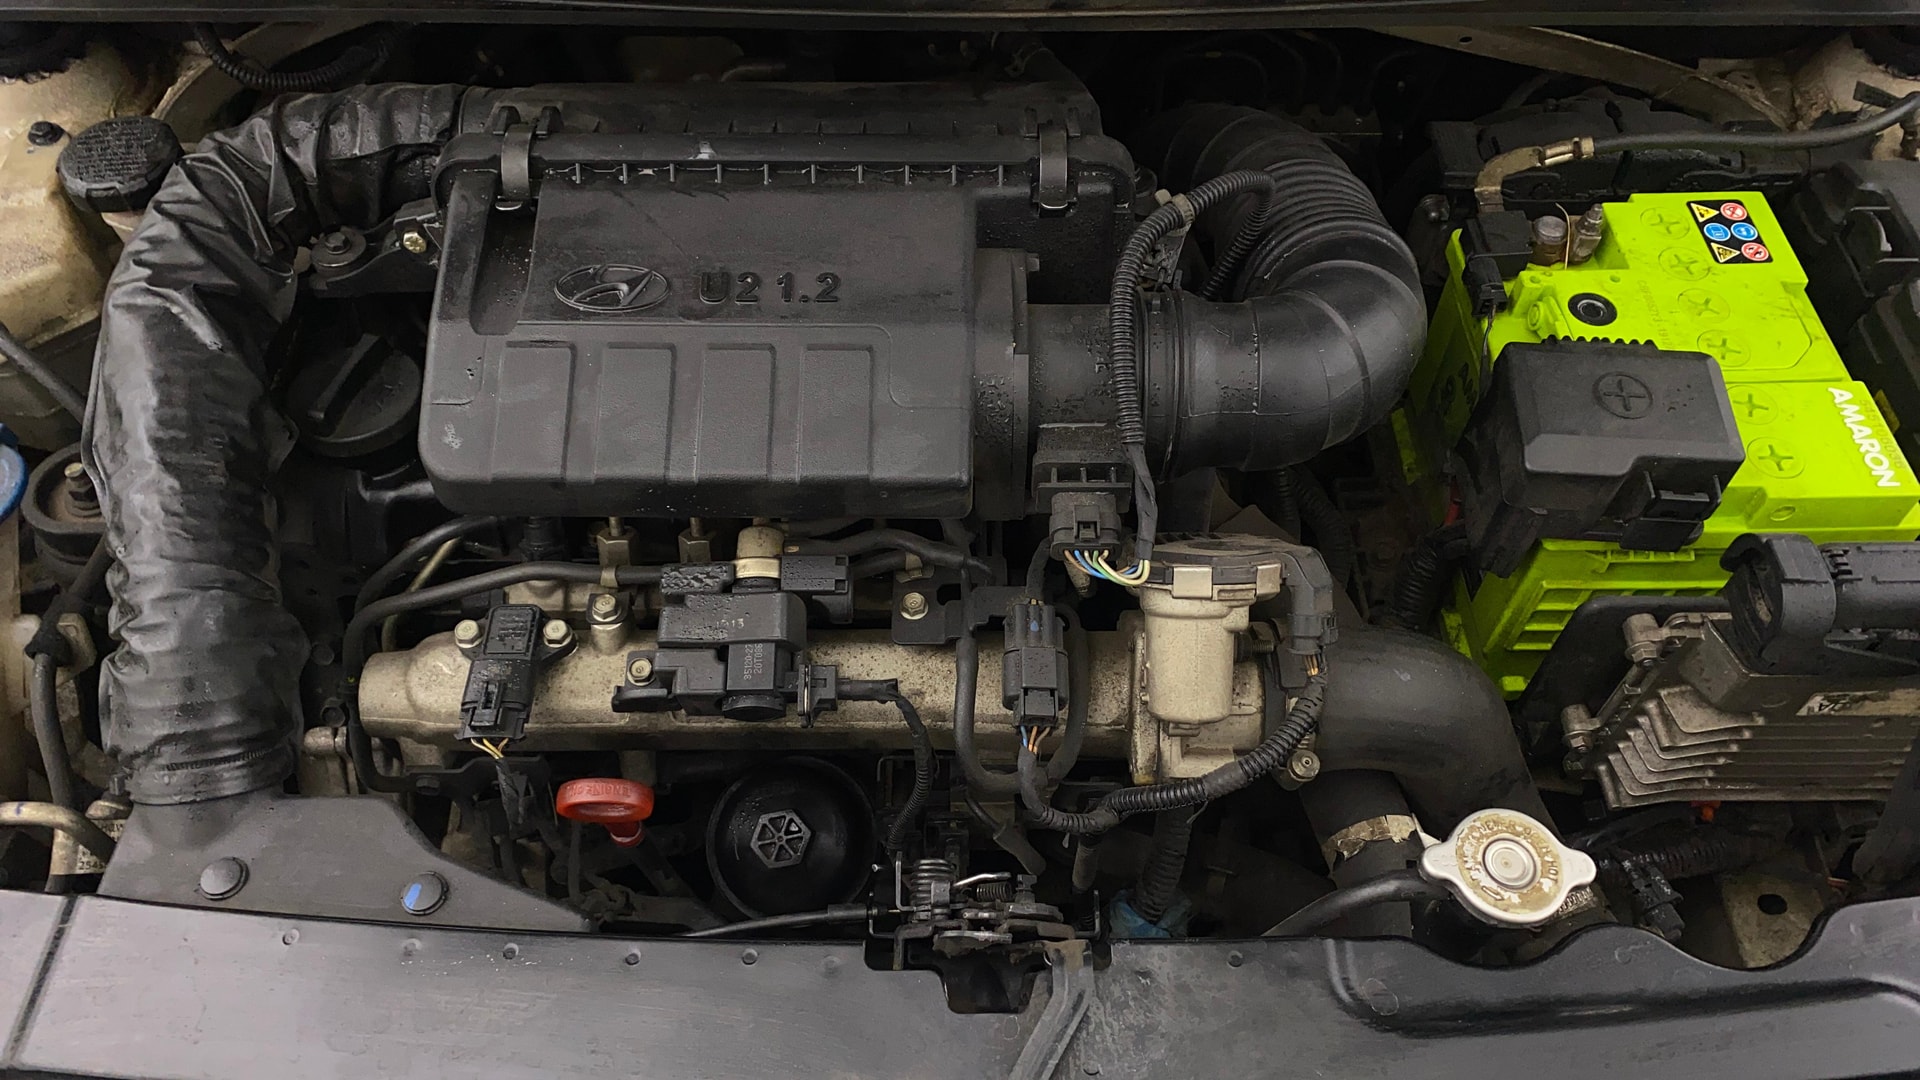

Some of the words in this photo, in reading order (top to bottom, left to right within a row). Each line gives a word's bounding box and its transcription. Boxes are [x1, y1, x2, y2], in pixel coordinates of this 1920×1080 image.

[699, 271, 761, 304] U2
[777, 271, 841, 303] 1.2
[1826, 387, 1901, 487] AMARON
